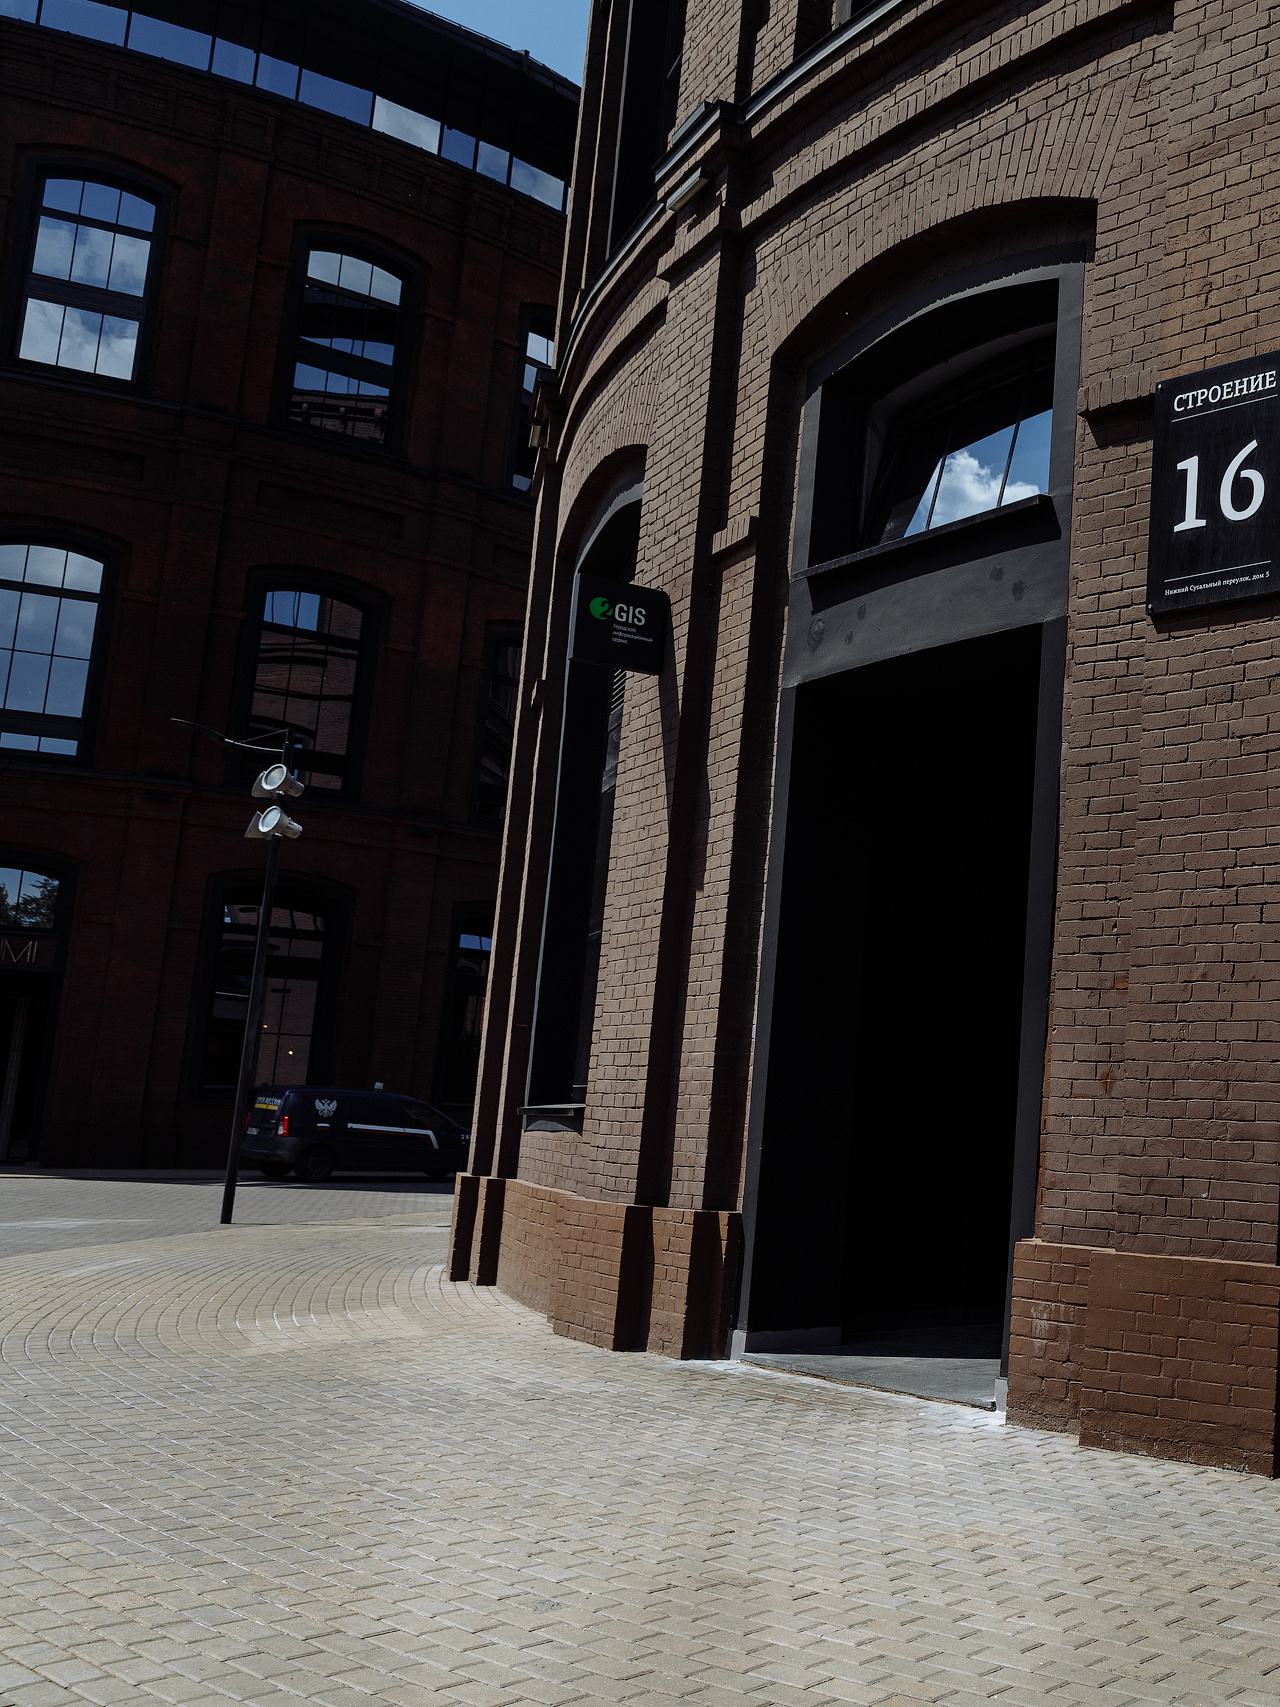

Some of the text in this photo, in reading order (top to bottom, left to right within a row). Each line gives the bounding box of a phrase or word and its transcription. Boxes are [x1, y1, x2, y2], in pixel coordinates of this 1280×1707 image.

[1173, 370, 1277, 412] СТРОЕНИЕ
[1173, 439, 1266, 533] 16
[1164, 585, 1189, 596] Нижний
[1189, 580, 1222, 592] Сусальный
[1251, 573, 1265, 581] дом
[1265, 570, 1270, 578] 5
[590, 597, 646, 626] 2GIS
